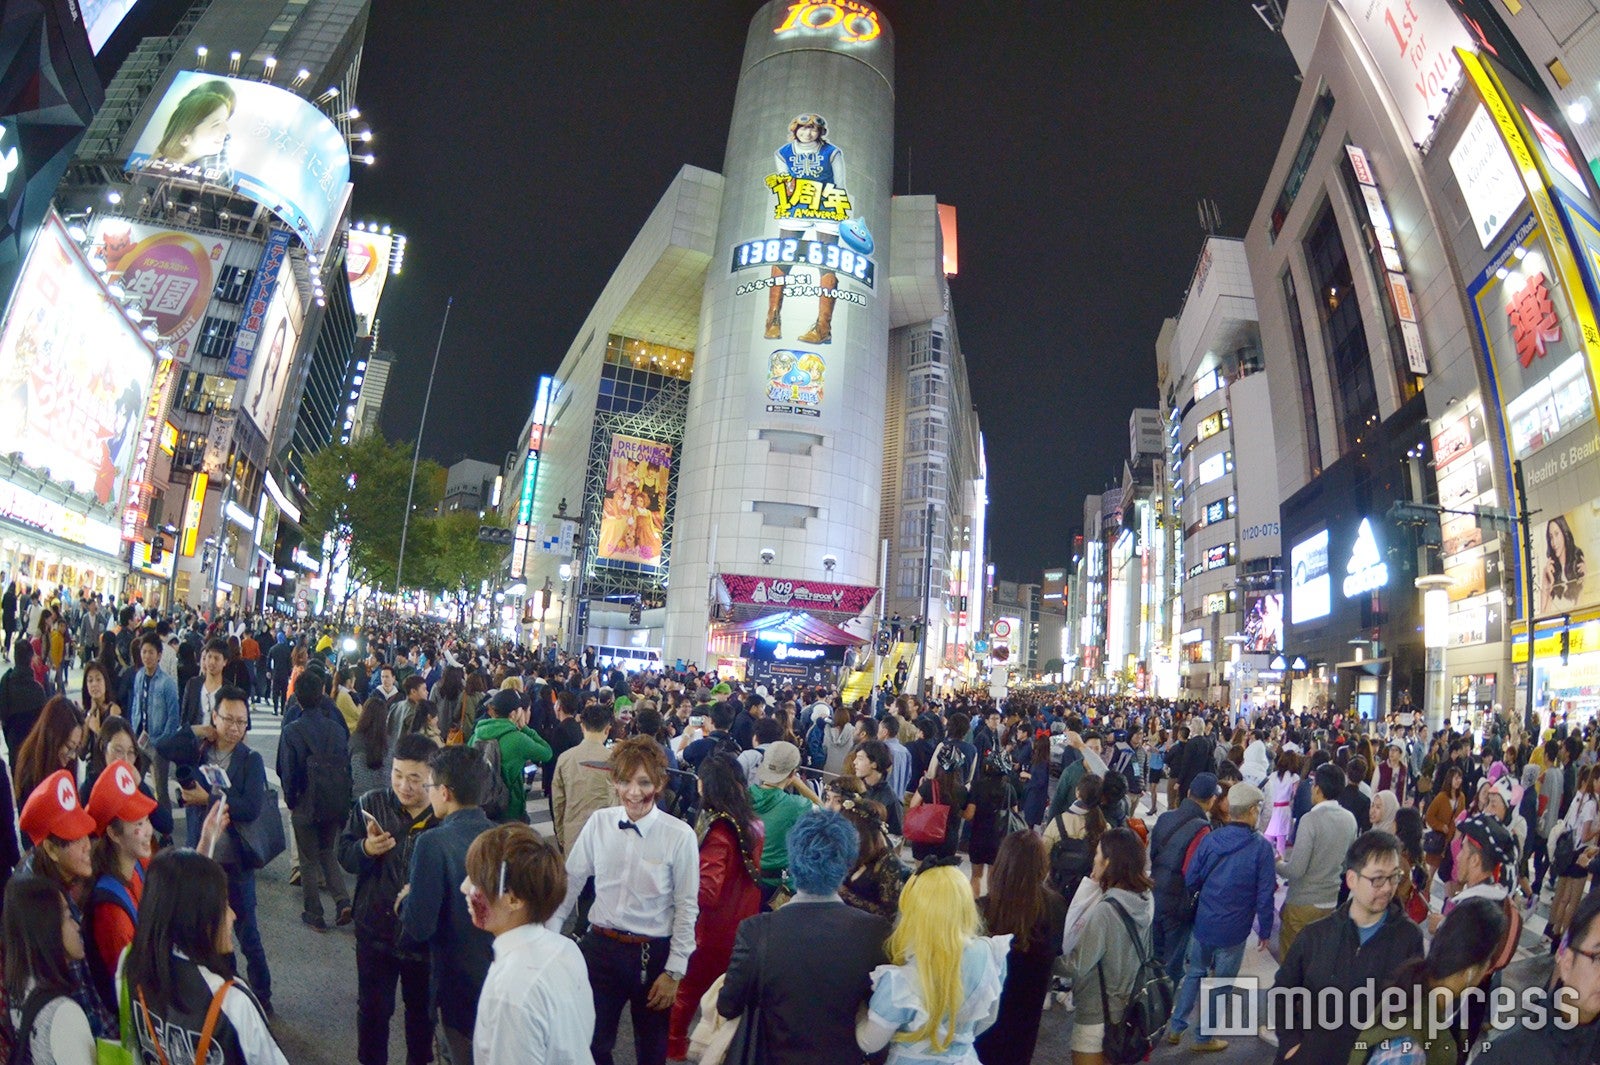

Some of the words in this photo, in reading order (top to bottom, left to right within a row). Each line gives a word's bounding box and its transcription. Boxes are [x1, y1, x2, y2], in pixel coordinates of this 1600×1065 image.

[773, 1, 881, 43] 109
[1410, 33, 1427, 70] for
[245, 244, 285, 332] テナント募集
[1504, 271, 1562, 369] 薬
[1527, 459, 1558, 488] Health
[1569, 433, 1600, 465] Beaut
[771, 579, 793, 594] 109
